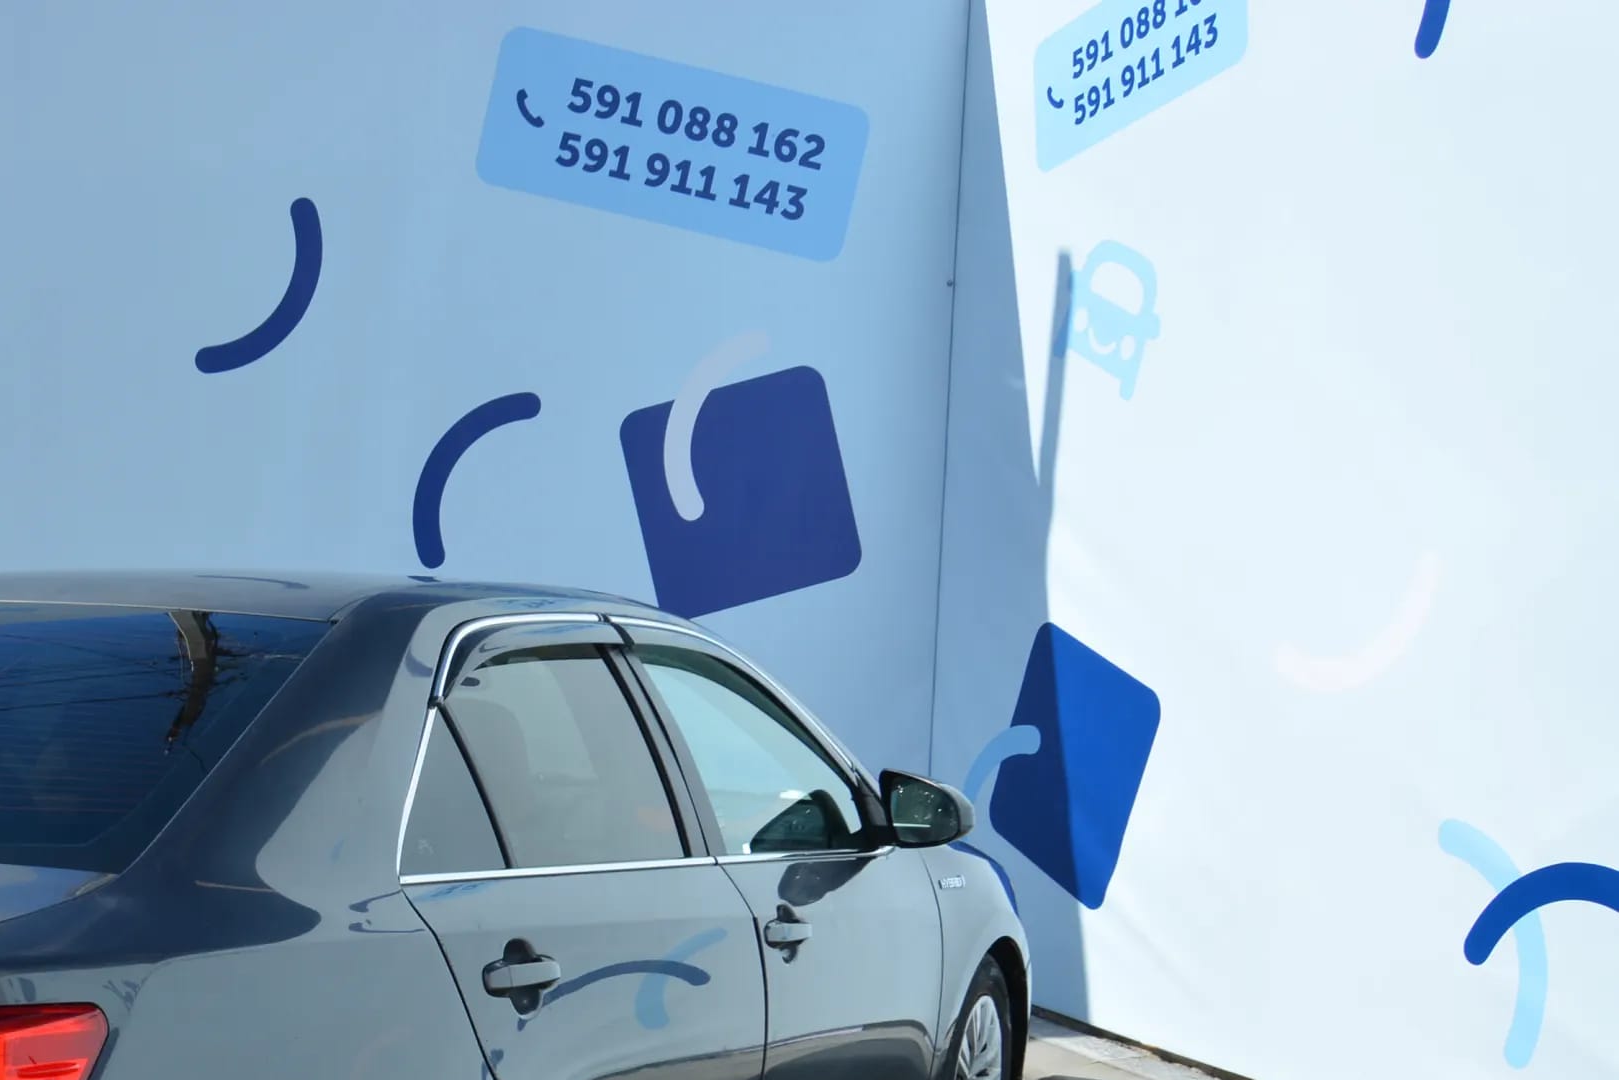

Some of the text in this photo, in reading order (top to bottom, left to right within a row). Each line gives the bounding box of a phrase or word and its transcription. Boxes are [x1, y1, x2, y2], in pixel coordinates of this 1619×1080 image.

[1073, 30, 1113, 79] 591
[1120, 0, 1166, 49] 088
[1074, 13, 1218, 125] 591 911 143
[567, 78, 826, 170] 591 088 162
[555, 131, 809, 221] 591 911 143
